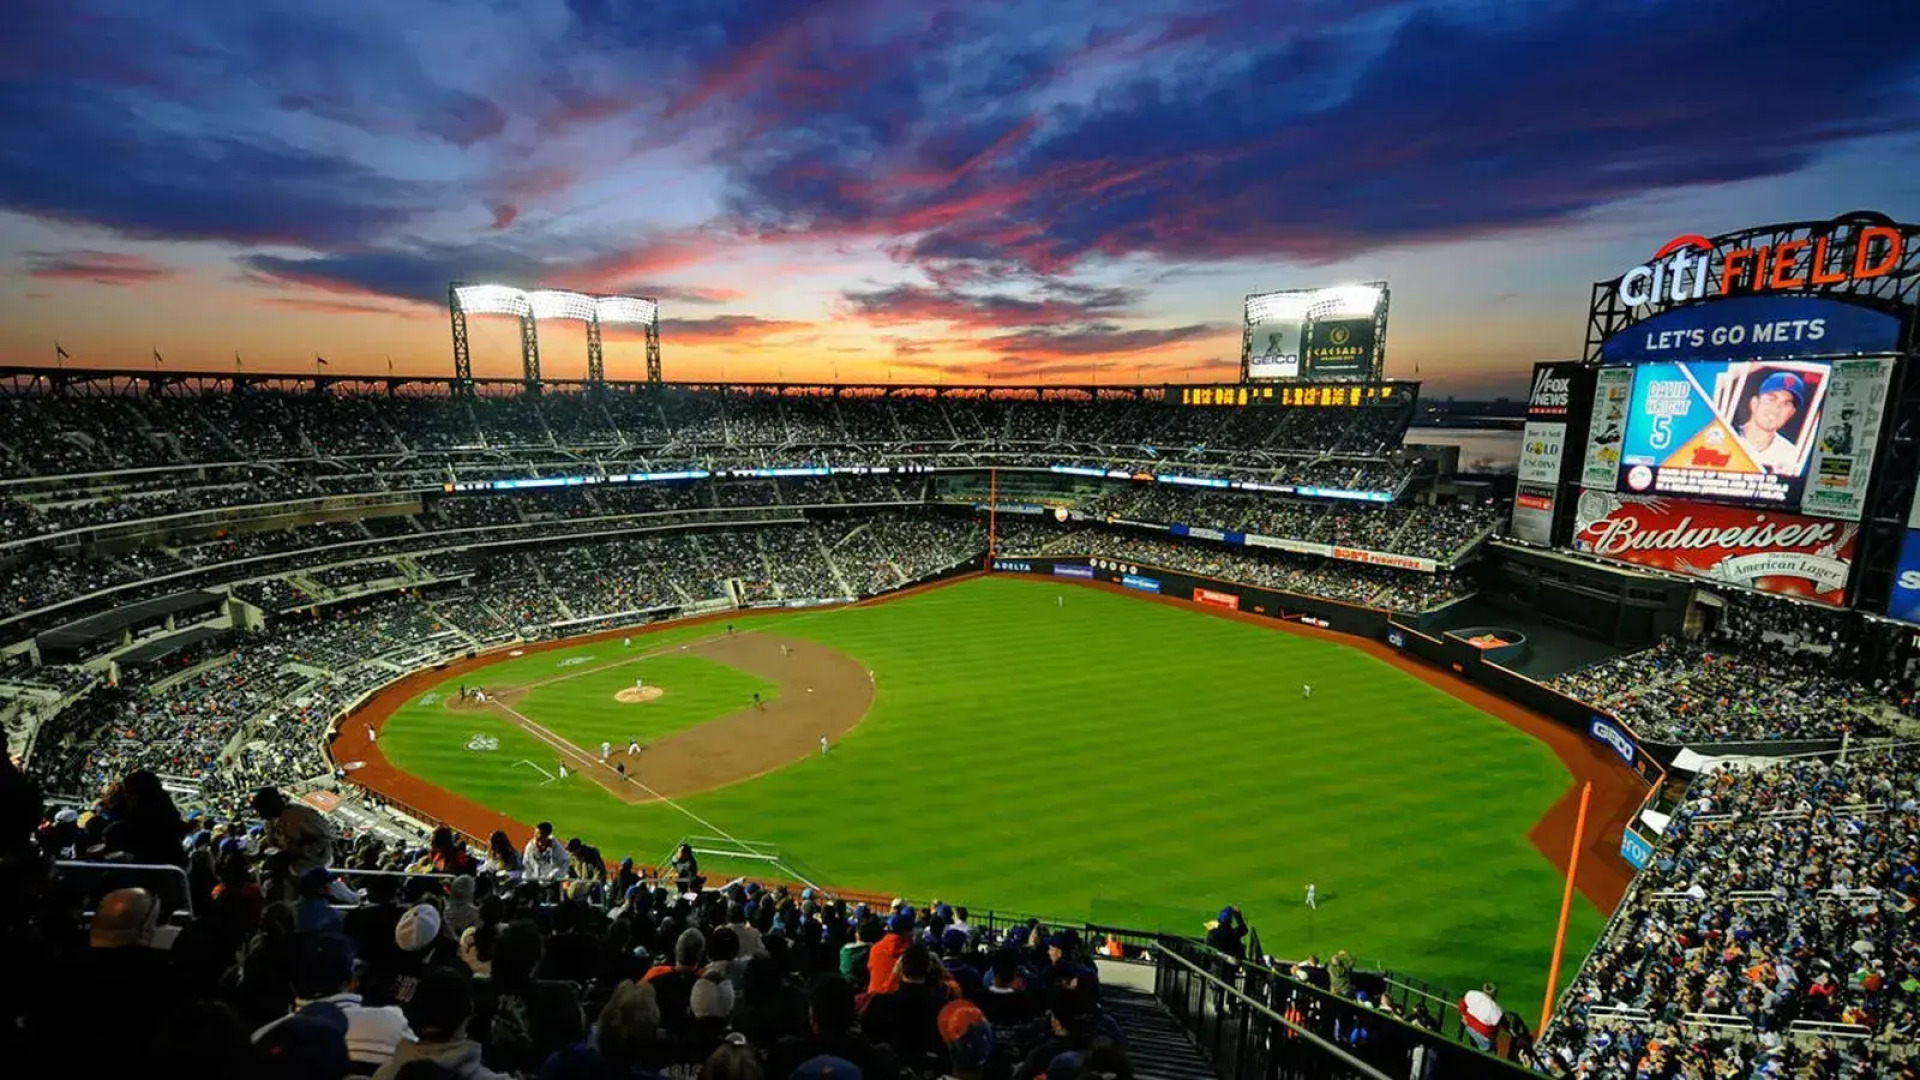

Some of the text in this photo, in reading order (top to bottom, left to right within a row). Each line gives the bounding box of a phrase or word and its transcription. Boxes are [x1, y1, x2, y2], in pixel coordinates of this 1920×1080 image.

[1619, 227, 1902, 307] citi FIELD
[1646, 319, 1826, 350] LET'S GO METS
[1253, 354, 1297, 365] GEICO
[1544, 378, 1570, 392] FOX
[1649, 381, 1690, 397] DAVID
[1535, 393, 1568, 406] NEWS
[1650, 415, 1671, 449] 5
[1588, 515, 1834, 555] Budweiser
[1002, 562, 1031, 571] DELTA
[1734, 560, 1841, 580] American Lager
[1593, 721, 1633, 761] GEICO
